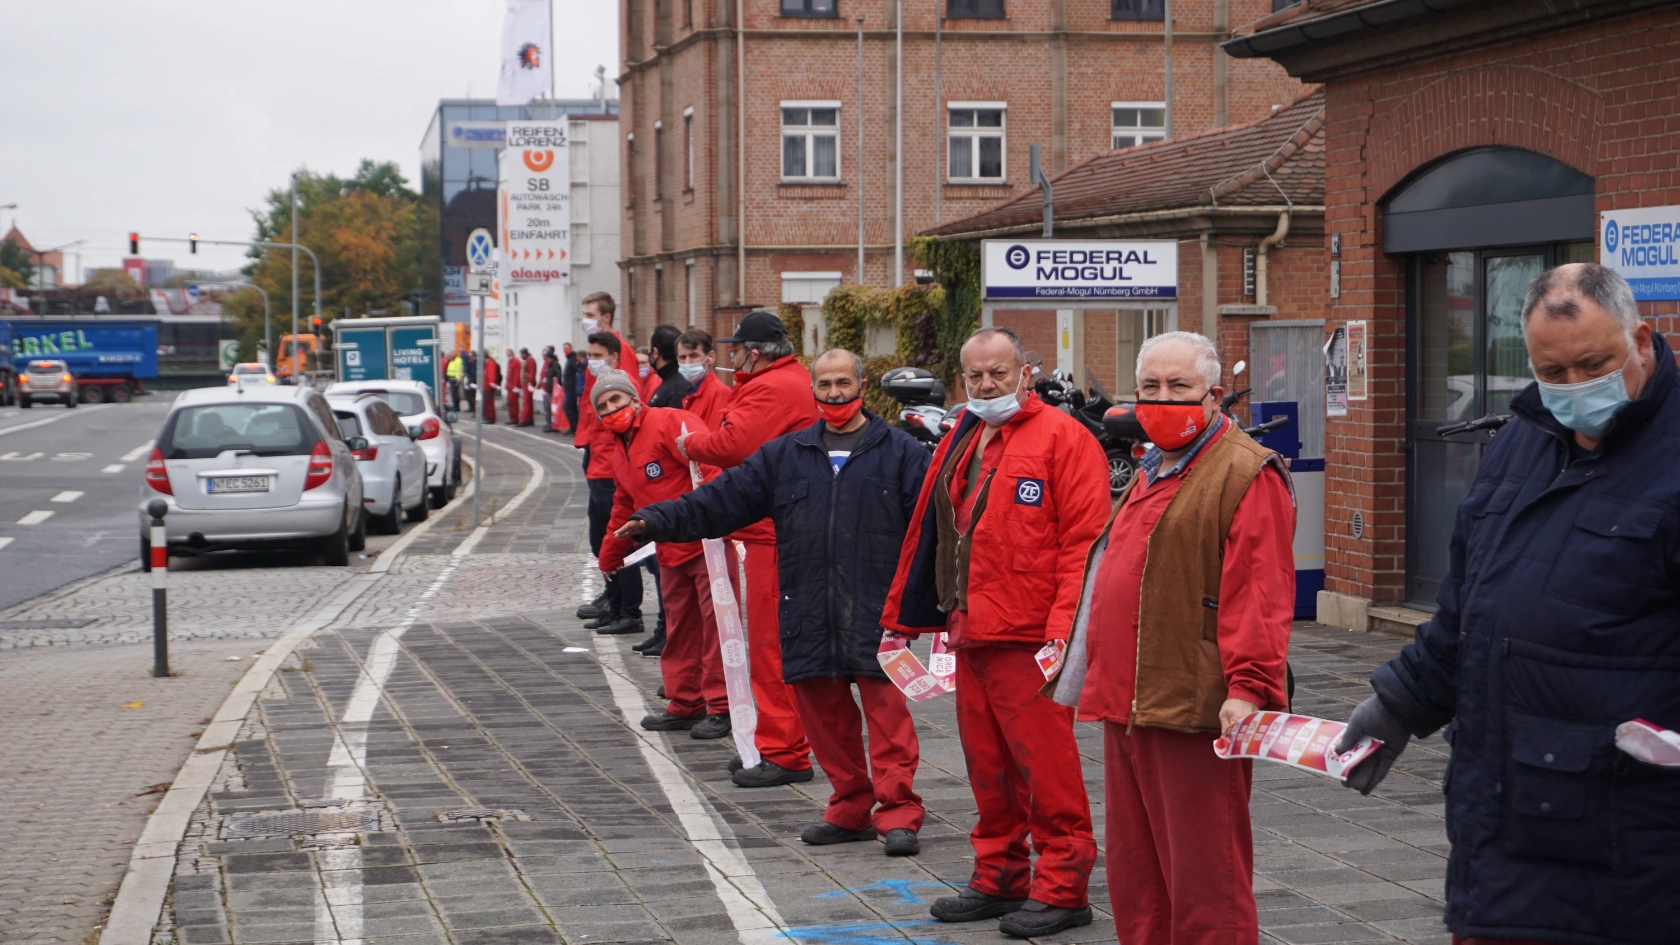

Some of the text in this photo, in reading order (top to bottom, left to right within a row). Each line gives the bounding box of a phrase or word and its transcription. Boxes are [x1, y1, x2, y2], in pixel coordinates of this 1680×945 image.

[512, 126, 563, 136] REIFEN
[509, 137, 566, 147] LORENZ
[527, 178, 550, 191] SB
[510, 193, 568, 201] AUTOWASCH
[526, 217, 550, 227] 20m
[510, 230, 567, 240] EINFAHRT
[1036, 250, 1157, 265] FEDERAL
[1621, 245, 1678, 267] MOGUL
[511, 267, 560, 282] alanya
[1036, 266, 1132, 281] MOGUL
[1035, 286, 1158, 296] Federal-Mogul Nürnberg GmbH
[393, 348, 423, 356] LIVING
[393, 355, 430, 364] HOTELS
[1020, 484, 1040, 499] ZF
[936, 656, 944, 673] NICE
[944, 656, 952, 673] ORGA
